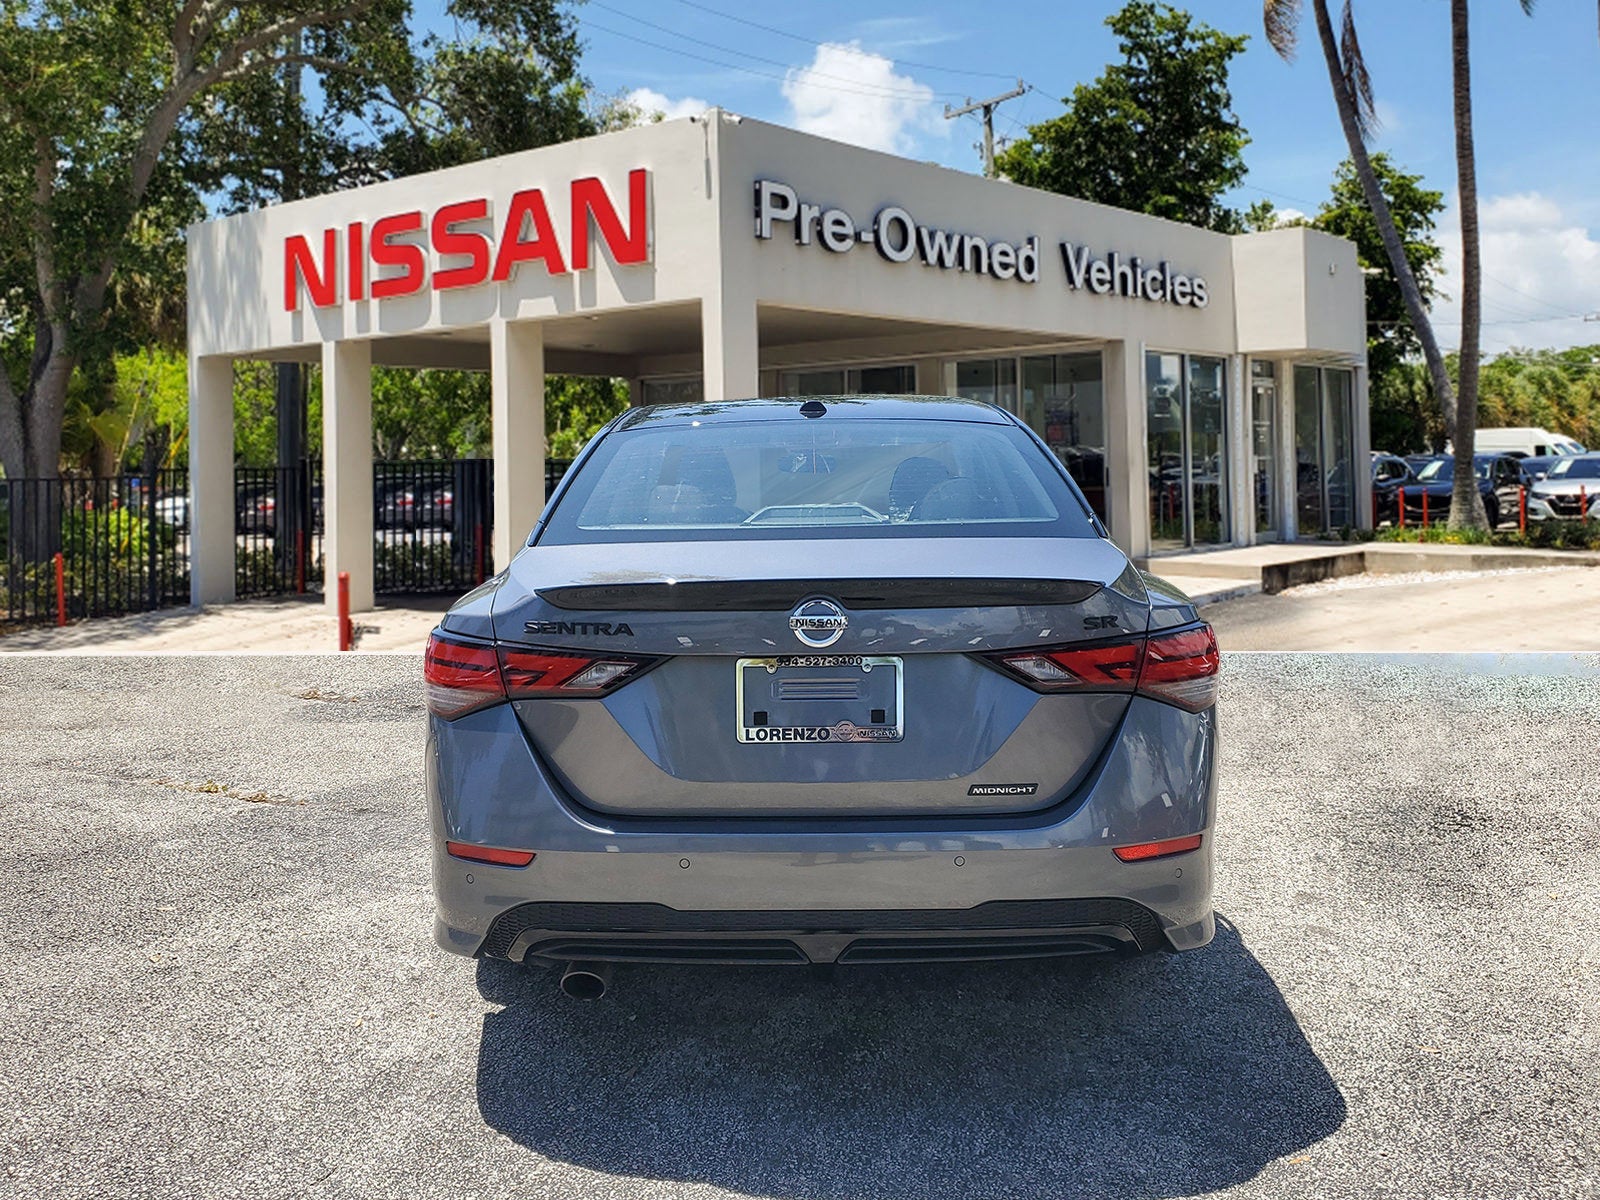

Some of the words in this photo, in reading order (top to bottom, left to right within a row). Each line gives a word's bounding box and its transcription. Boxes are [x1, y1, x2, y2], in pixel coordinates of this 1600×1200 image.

[284, 168, 649, 312] NISSAN
[754, 179, 1040, 283] Pre-Owned
[1060, 241, 1209, 308] Vehicles
[523, 620, 635, 637] SENTRA
[795, 618, 842, 628] NISSAN
[1083, 615, 1119, 630] SR
[745, 727, 831, 742] LORENZO
[859, 728, 897, 739] NISSAN
[972, 786, 1035, 794] MIDNIGHT
